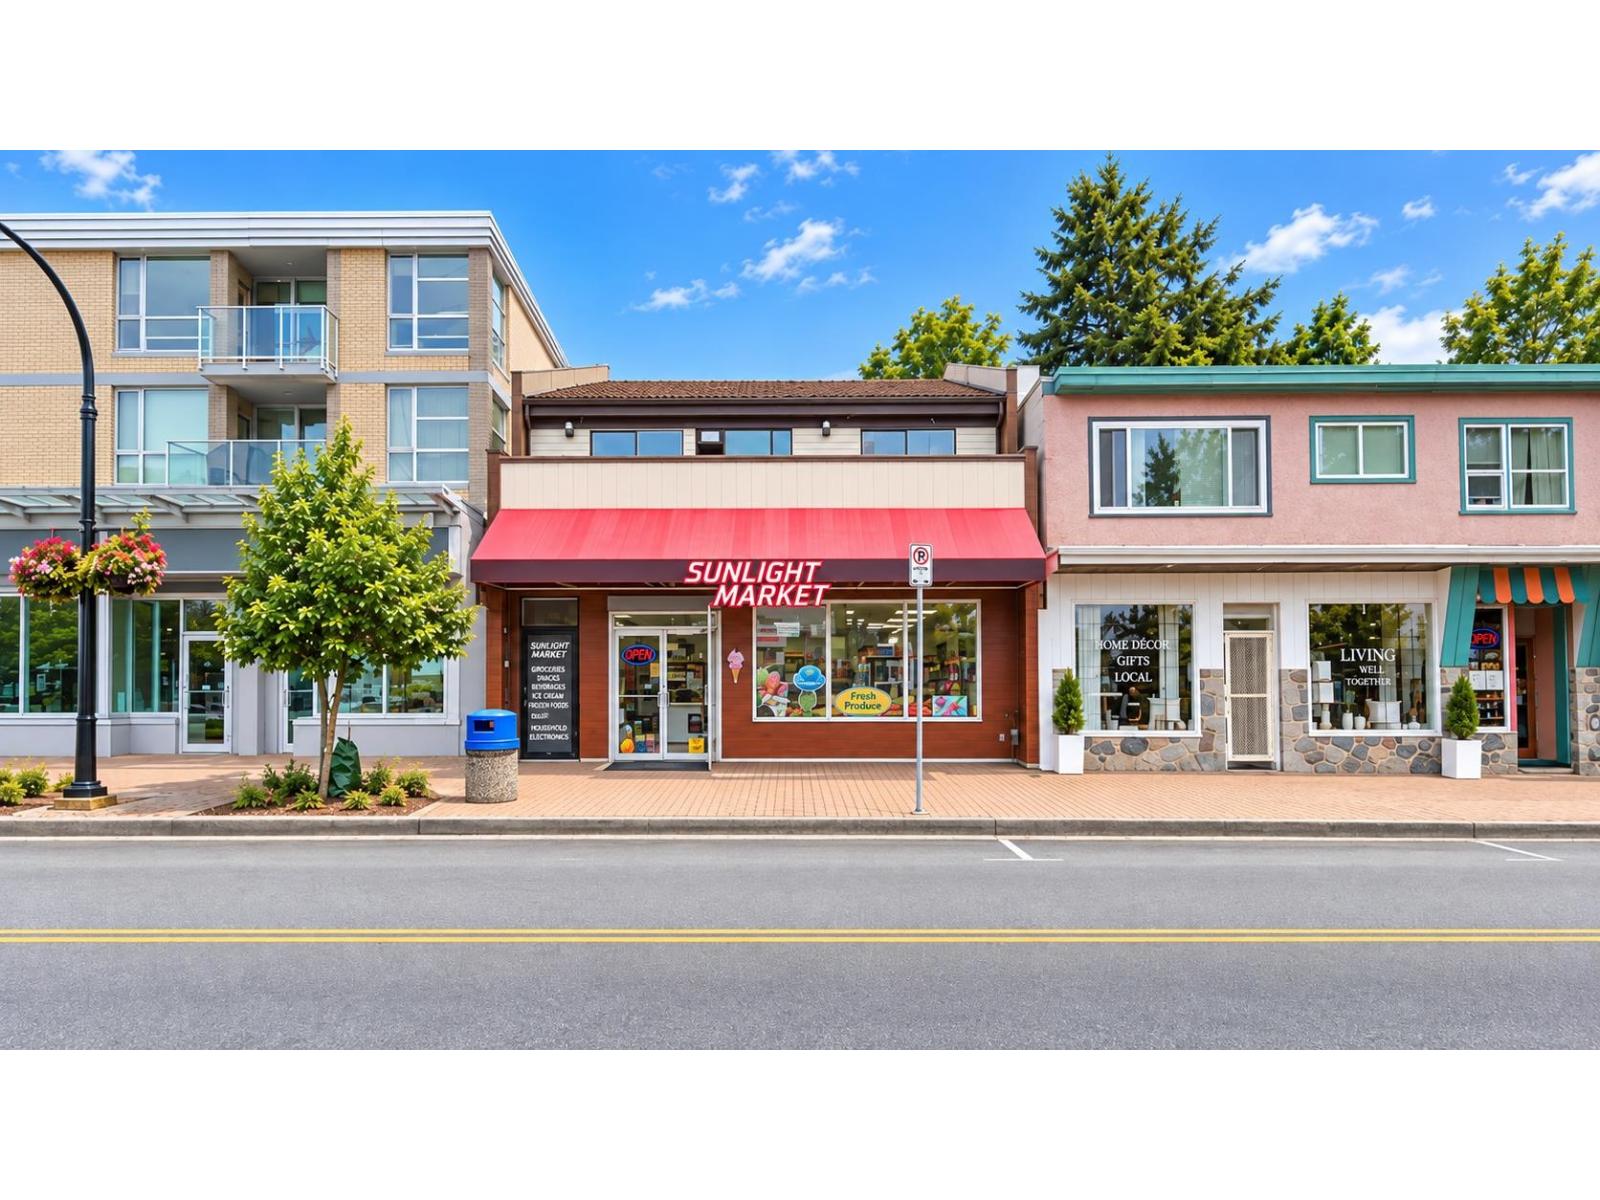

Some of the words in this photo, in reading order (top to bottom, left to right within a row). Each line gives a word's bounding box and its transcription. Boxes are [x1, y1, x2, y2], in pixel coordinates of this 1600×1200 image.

[684, 560, 823, 583] SUNLIGHT
[713, 584, 832, 606] MARKET
[530, 641, 571, 650] SUNLIGHT
[1095, 639, 1129, 650] HOME
[1131, 637, 1171, 650] DÉCOR
[531, 650, 568, 659] MARKET
[623, 649, 653, 661] OPEN
[1340, 647, 1397, 662] LIVING
[1116, 655, 1150, 666] GIFTS
[531, 665, 566, 673] GROCERIES
[1359, 665, 1385, 674] WELL
[1114, 671, 1153, 683] LOCAL
[1344, 677, 1392, 686] TOGETHER
[850, 691, 876, 701] Fresh
[844, 701, 882, 711] Produce
